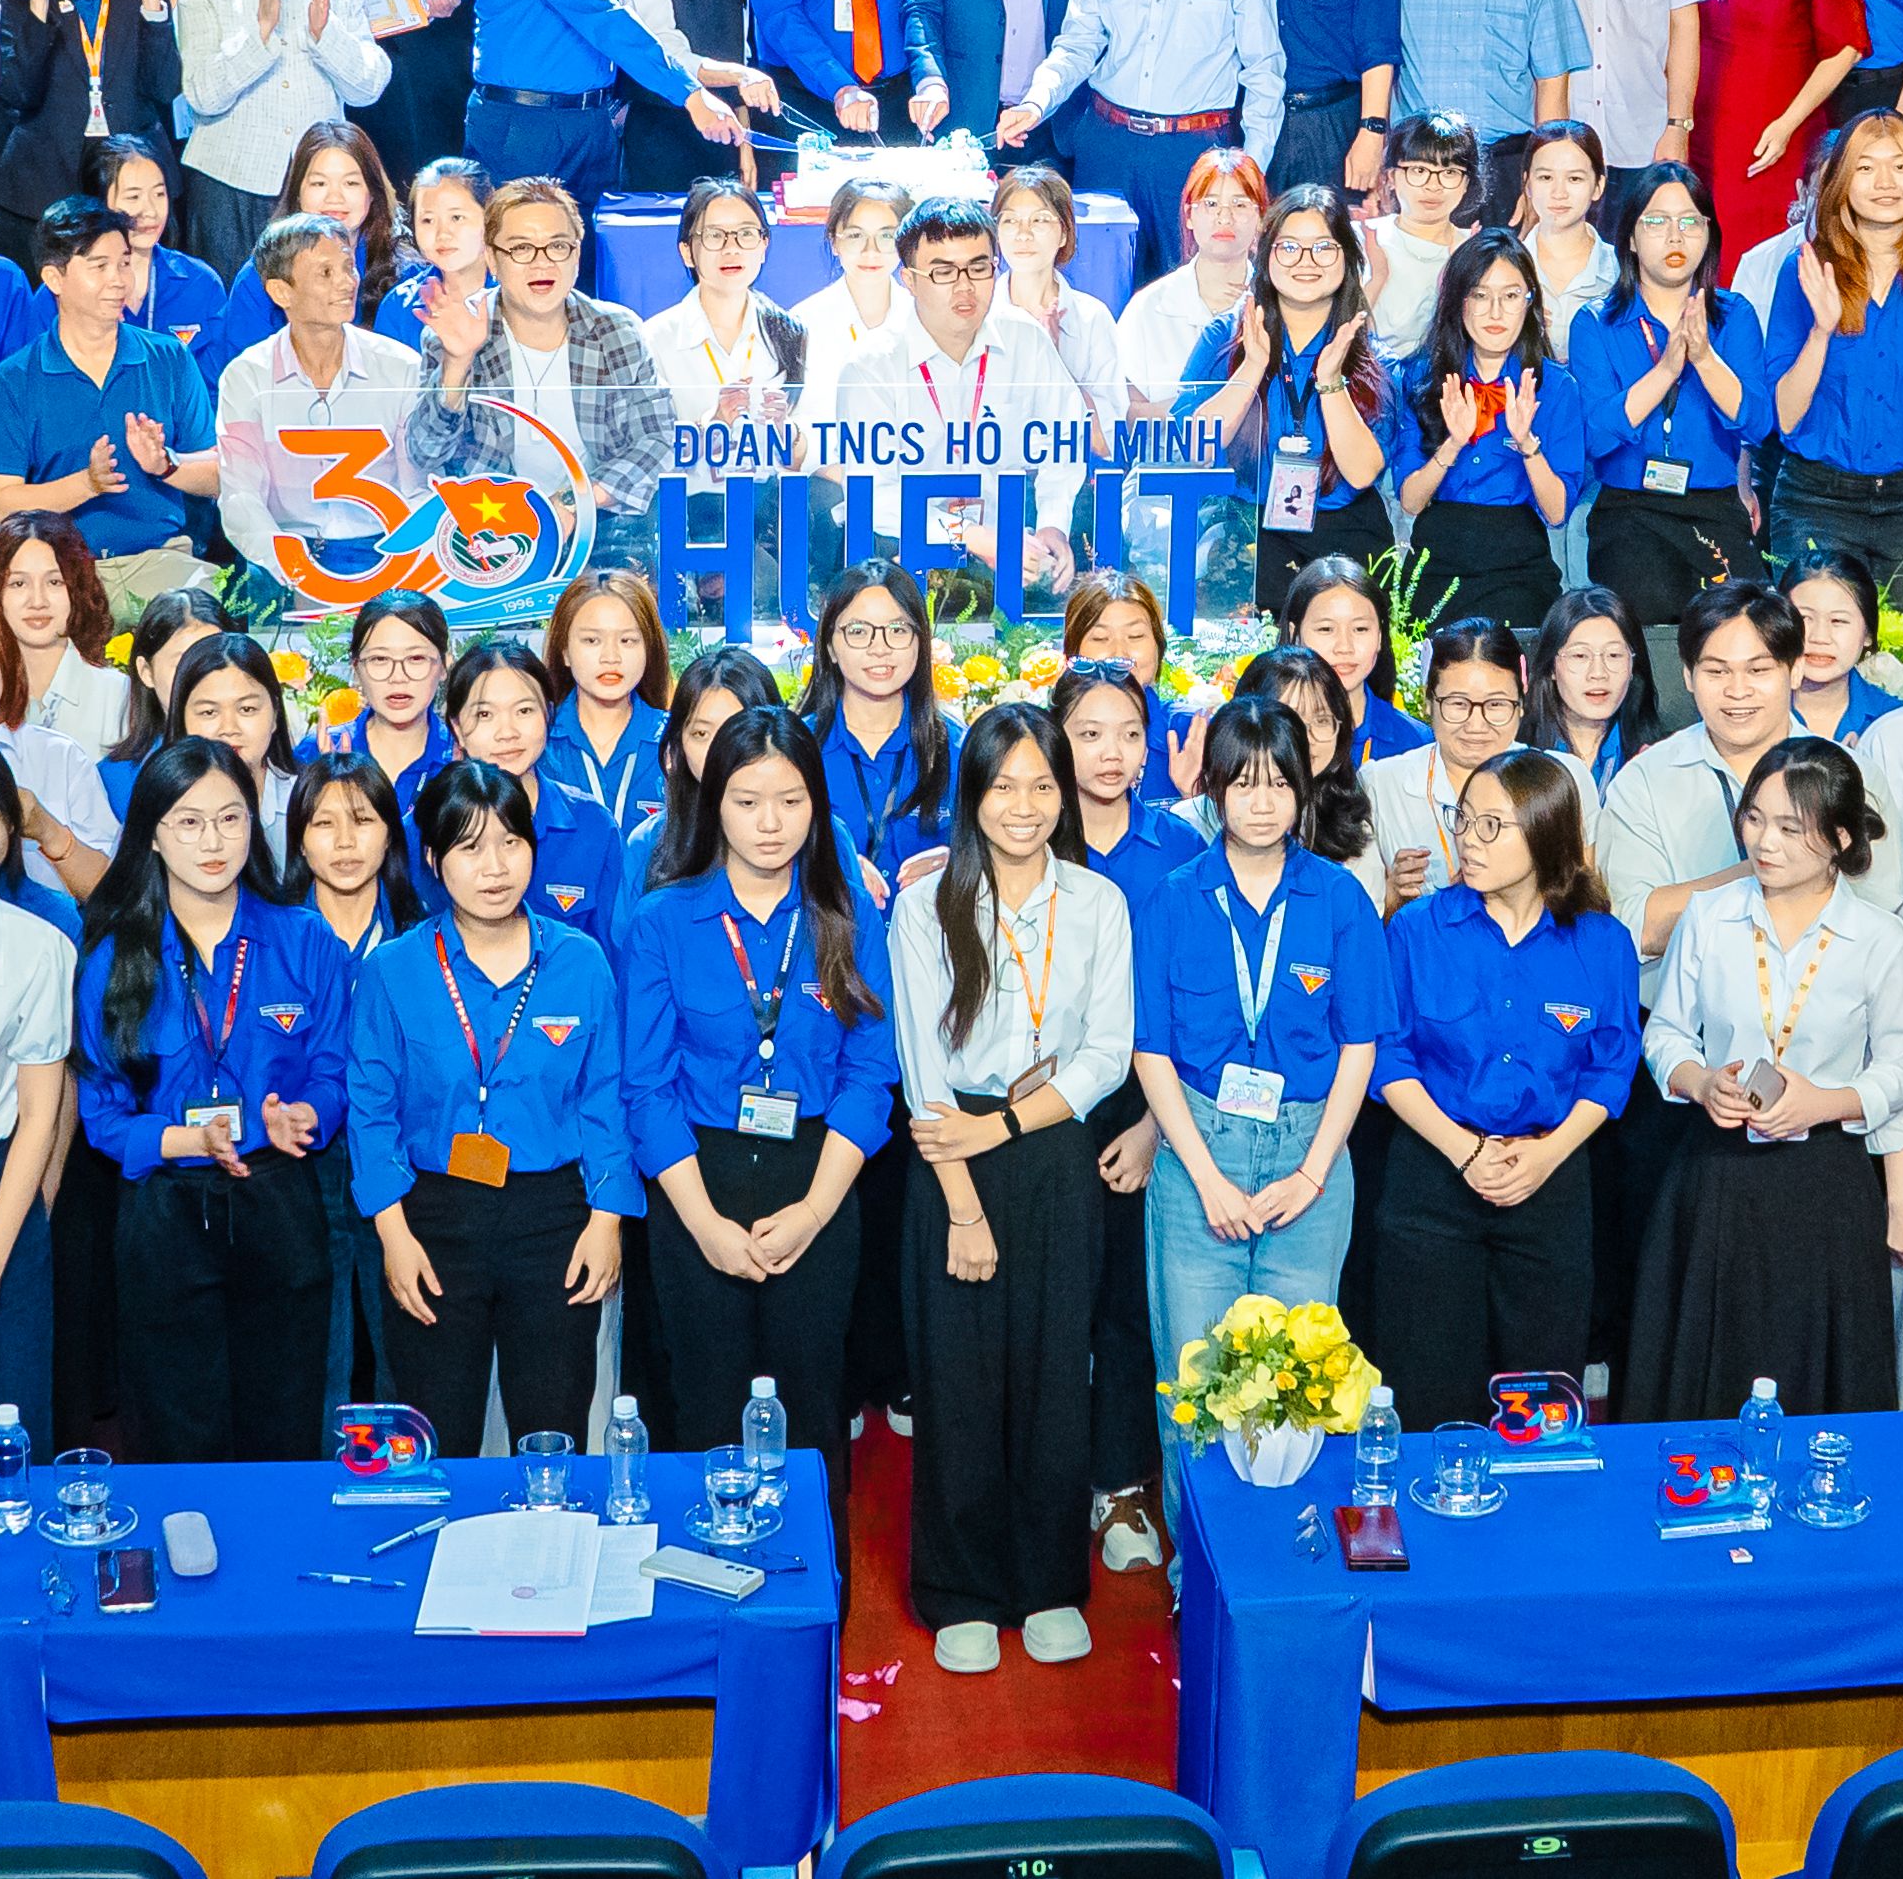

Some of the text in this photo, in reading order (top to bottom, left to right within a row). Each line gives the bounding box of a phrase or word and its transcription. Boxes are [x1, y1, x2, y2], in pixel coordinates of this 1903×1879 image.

[673, 405, 1224, 469] ĐOÀN TNCS HỒ CHÍ MINH
[657, 467, 1236, 646] HUFLIT
[501, 596, 536, 614] 1996
[1532, 1836, 1561, 1854] 9
[1017, 1859, 1047, 1877] 10
